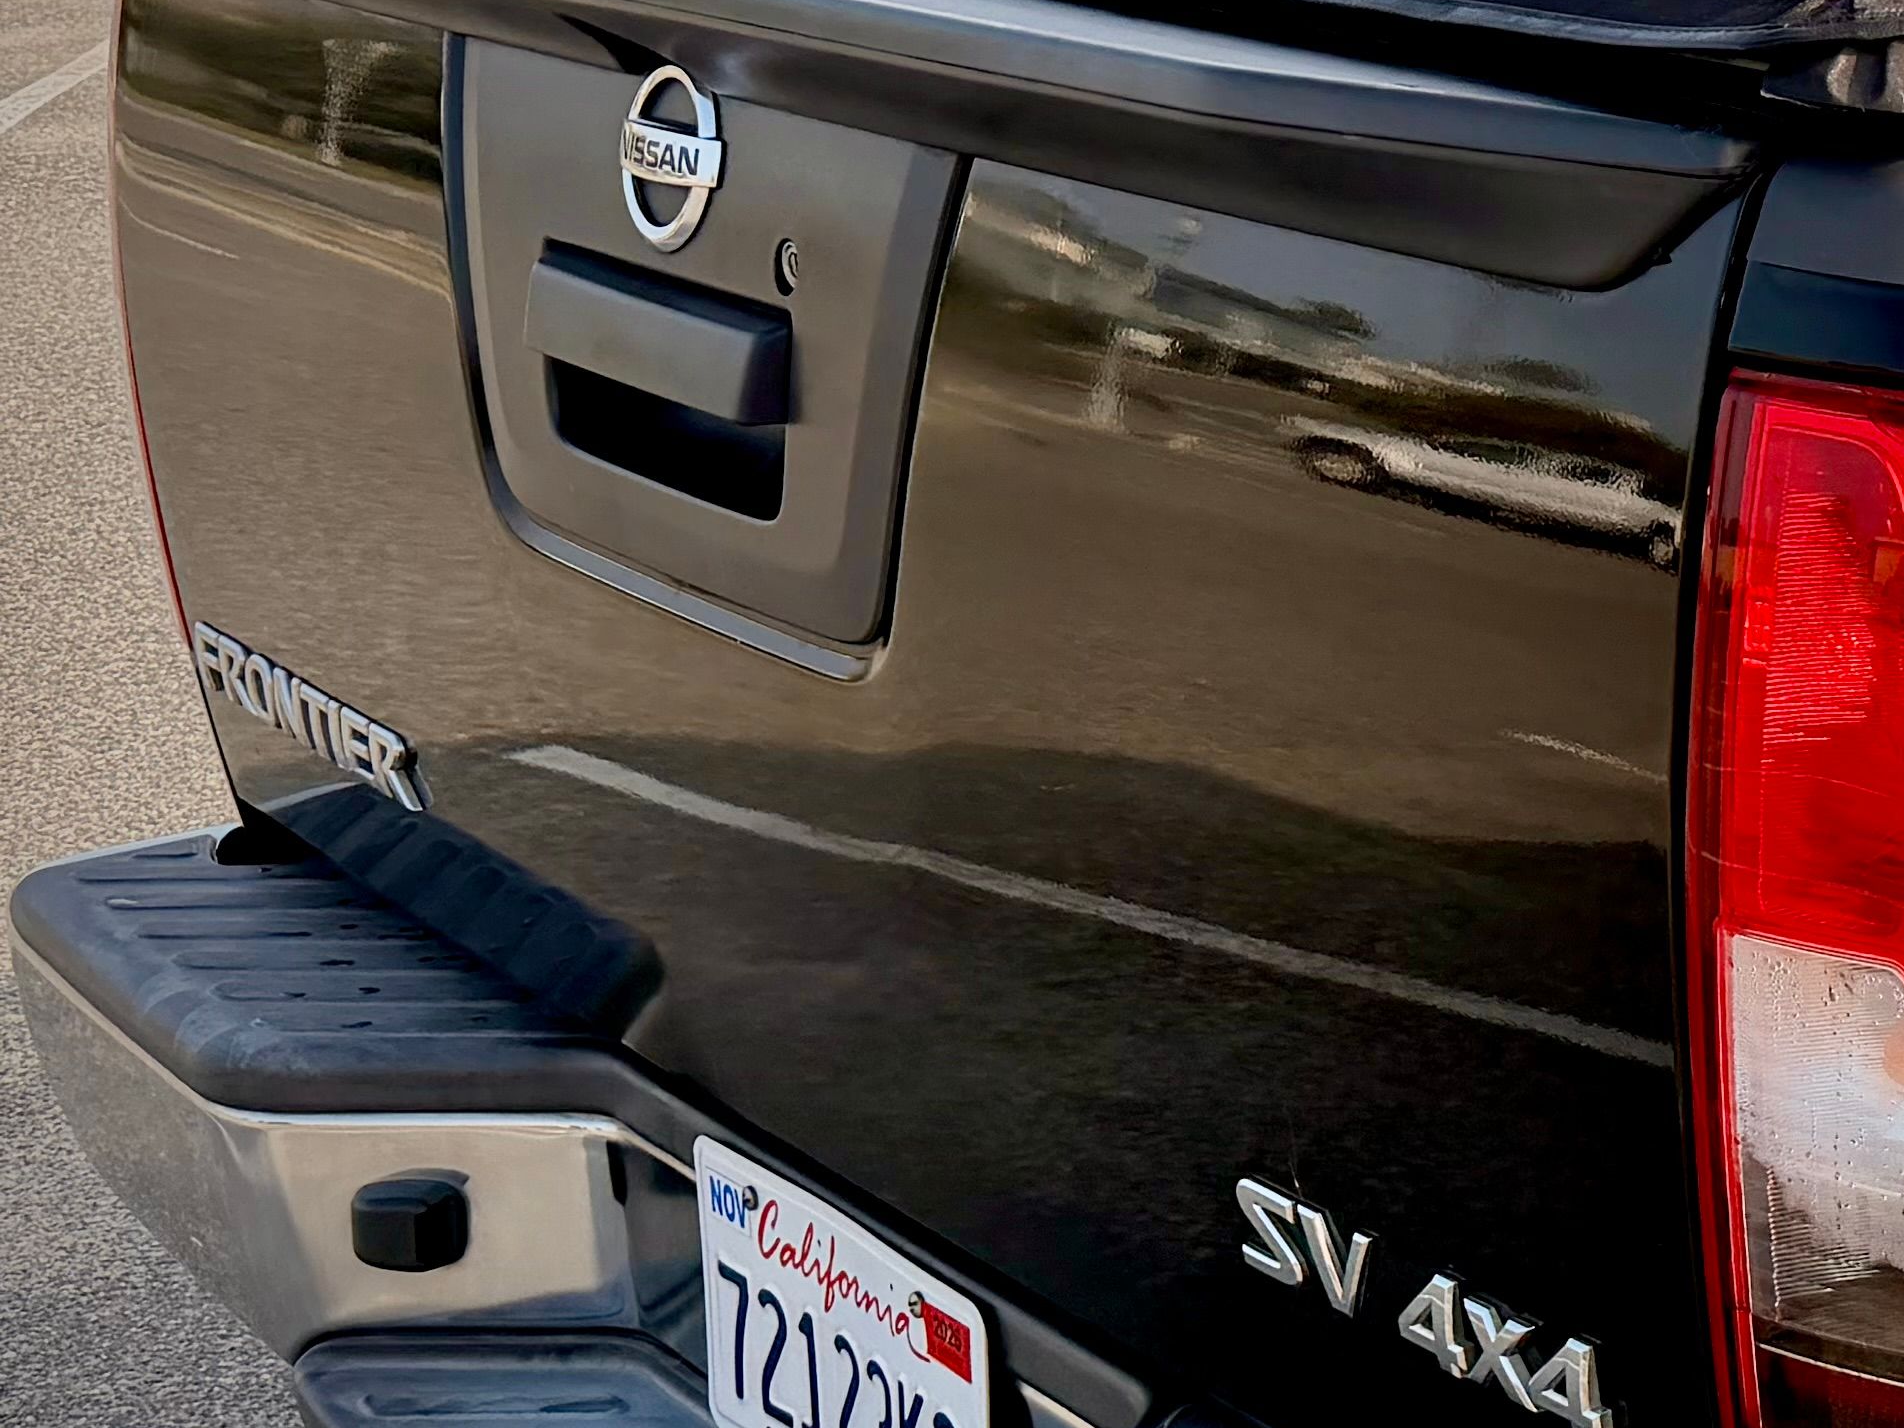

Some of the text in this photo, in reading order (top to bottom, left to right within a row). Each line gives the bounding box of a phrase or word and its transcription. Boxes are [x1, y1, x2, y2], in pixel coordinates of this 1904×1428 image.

[622, 128, 701, 177] NISSAN
[194, 620, 425, 812] FRONTIER
[709, 1175, 752, 1229] NOV
[1236, 1178, 1374, 1320] SV
[757, 1199, 931, 1364] California
